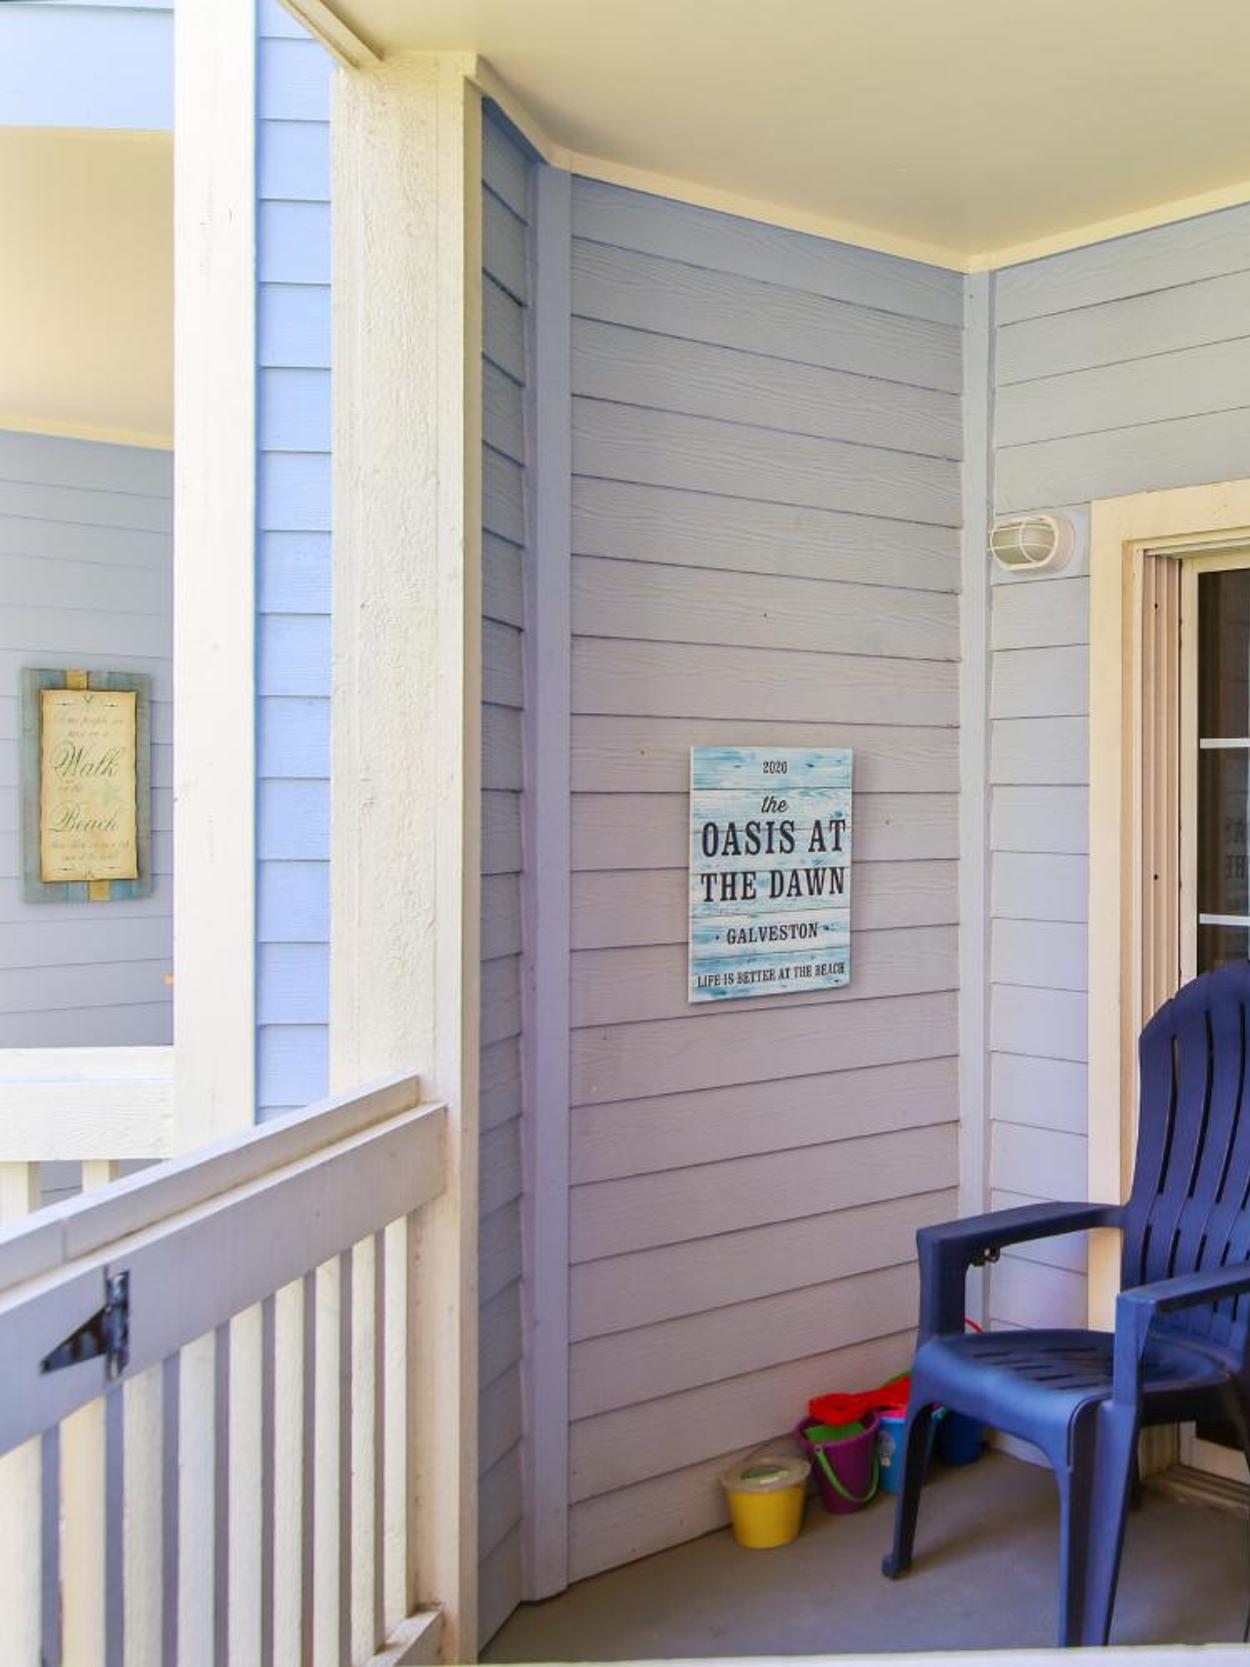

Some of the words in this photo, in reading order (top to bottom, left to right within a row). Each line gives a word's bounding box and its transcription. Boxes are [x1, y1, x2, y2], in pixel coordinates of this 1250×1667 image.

[53, 742, 124, 778] Walk
[762, 760, 788, 774] 2020
[50, 801, 121, 833] Beach
[761, 795, 788, 813] the
[702, 819, 795, 857] OASIS
[808, 819, 846, 853] AT
[700, 871, 756, 903] THE
[769, 866, 845, 898] DAWN
[726, 922, 818, 945] GALVESTON
[697, 975, 721, 988] LIFE
[723, 972, 734, 985] IS
[737, 969, 776, 984] BETTER
[778, 967, 791, 980] AT
[794, 964, 812, 978] THE
